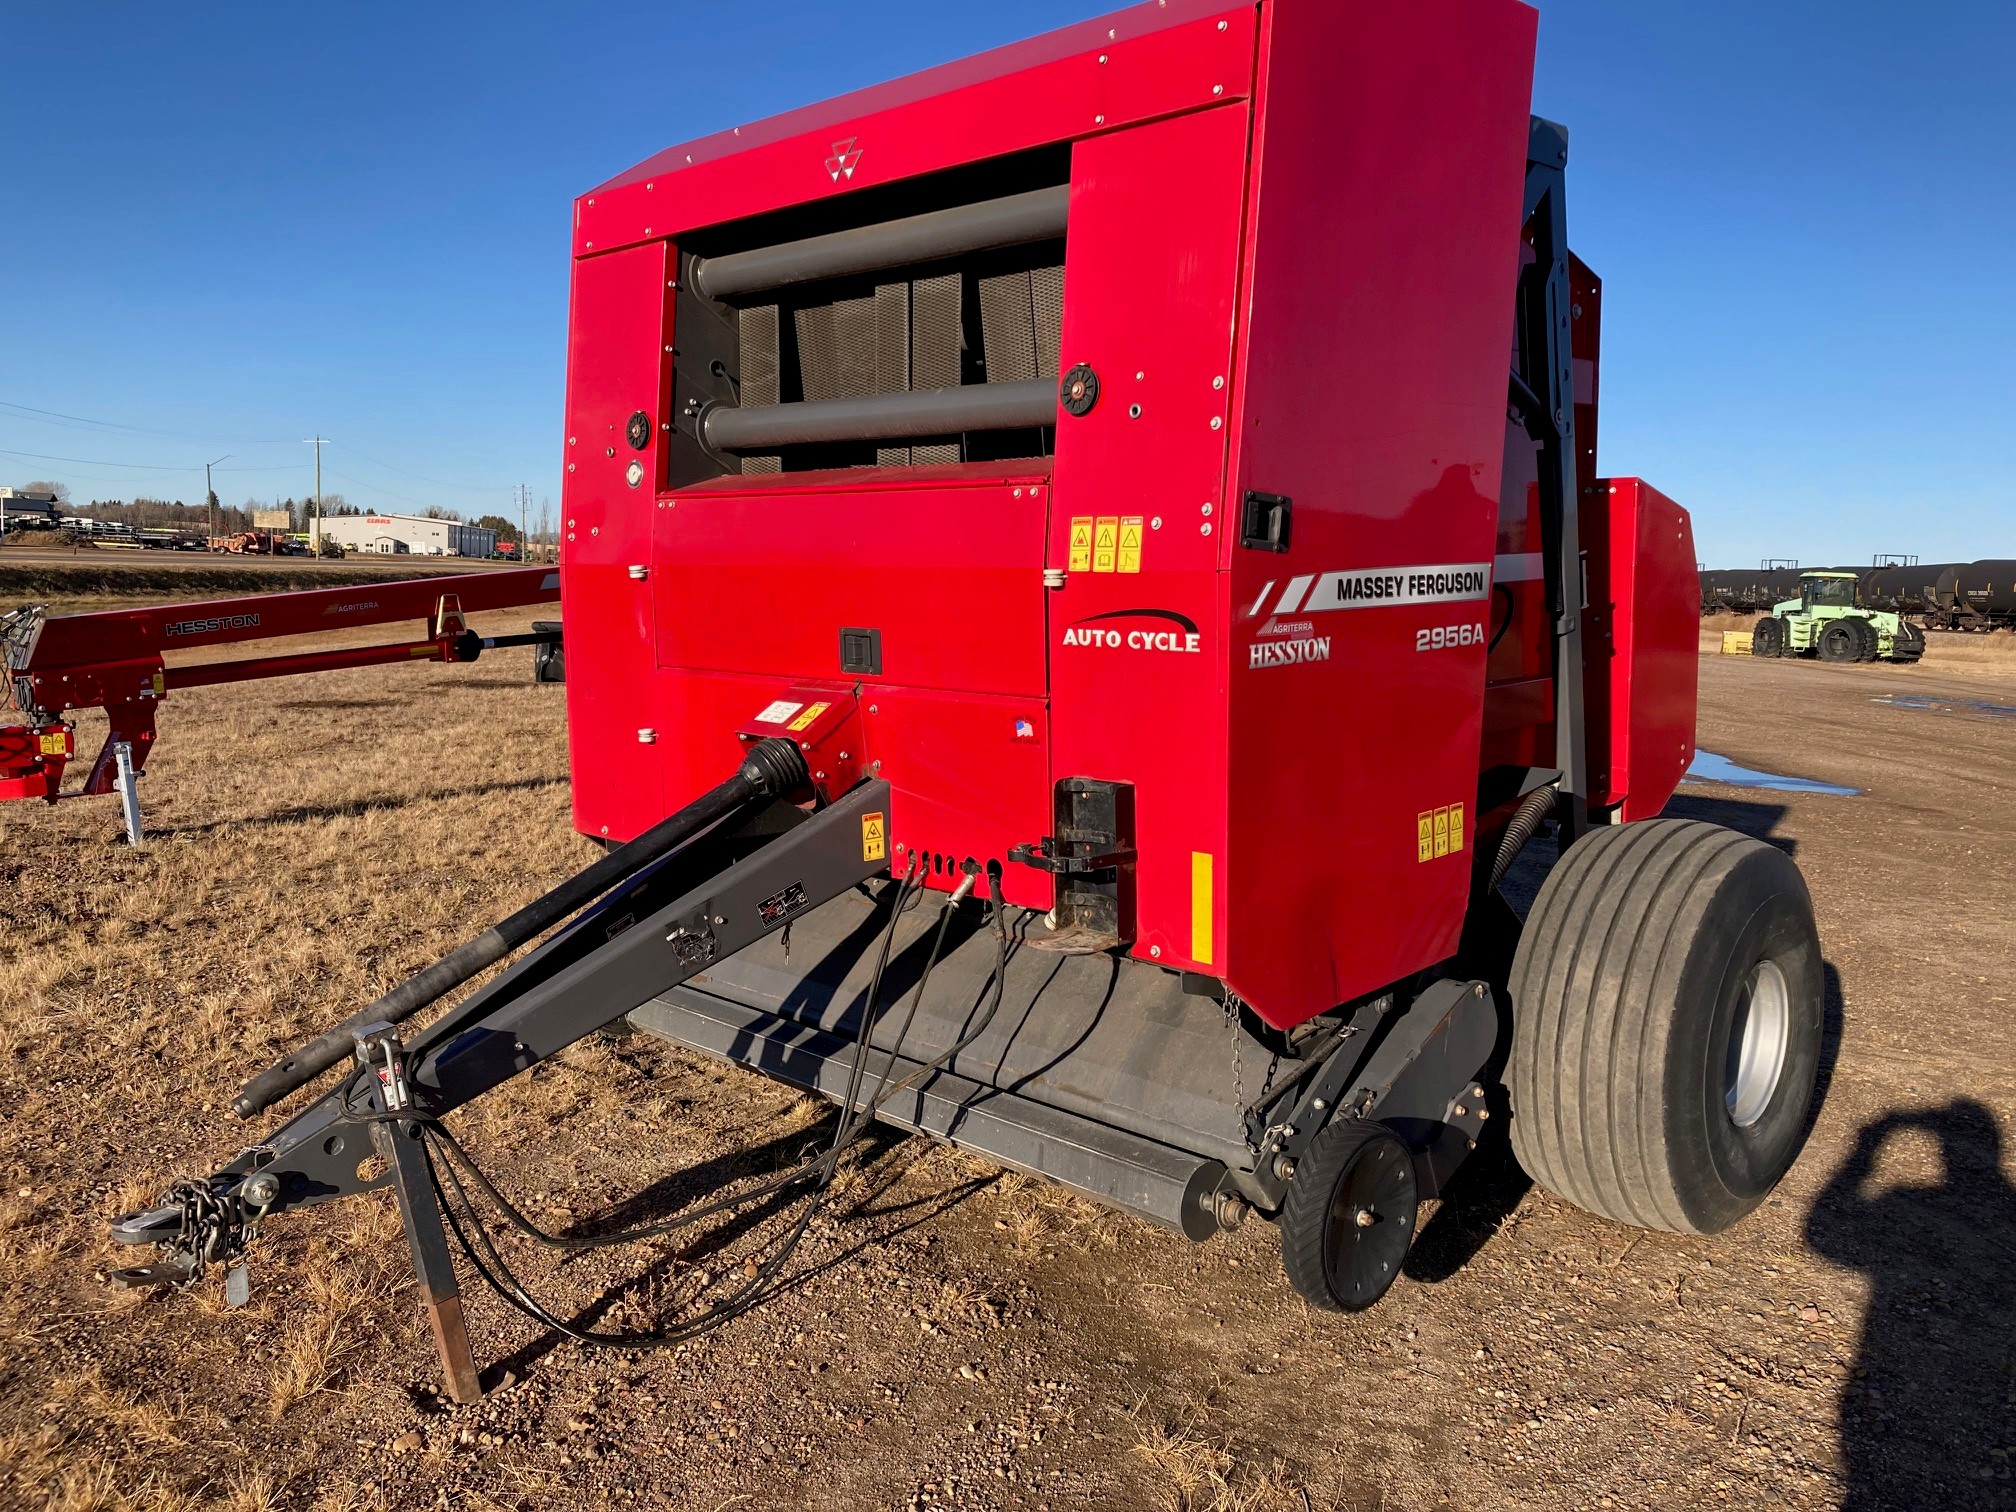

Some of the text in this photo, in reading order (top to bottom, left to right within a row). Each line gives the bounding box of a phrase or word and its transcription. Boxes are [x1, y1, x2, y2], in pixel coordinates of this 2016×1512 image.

[1337, 571, 1483, 601] MASSEY FERGUSON
[338, 601, 379, 614] AGRITERRA
[166, 614, 260, 636] HESSTON
[1272, 621, 1313, 634] AGRITERRA
[1415, 623, 1484, 651] 2956A
[1062, 629, 1200, 653] AUTO CYCLE
[1248, 636, 1330, 669] HESSTON
